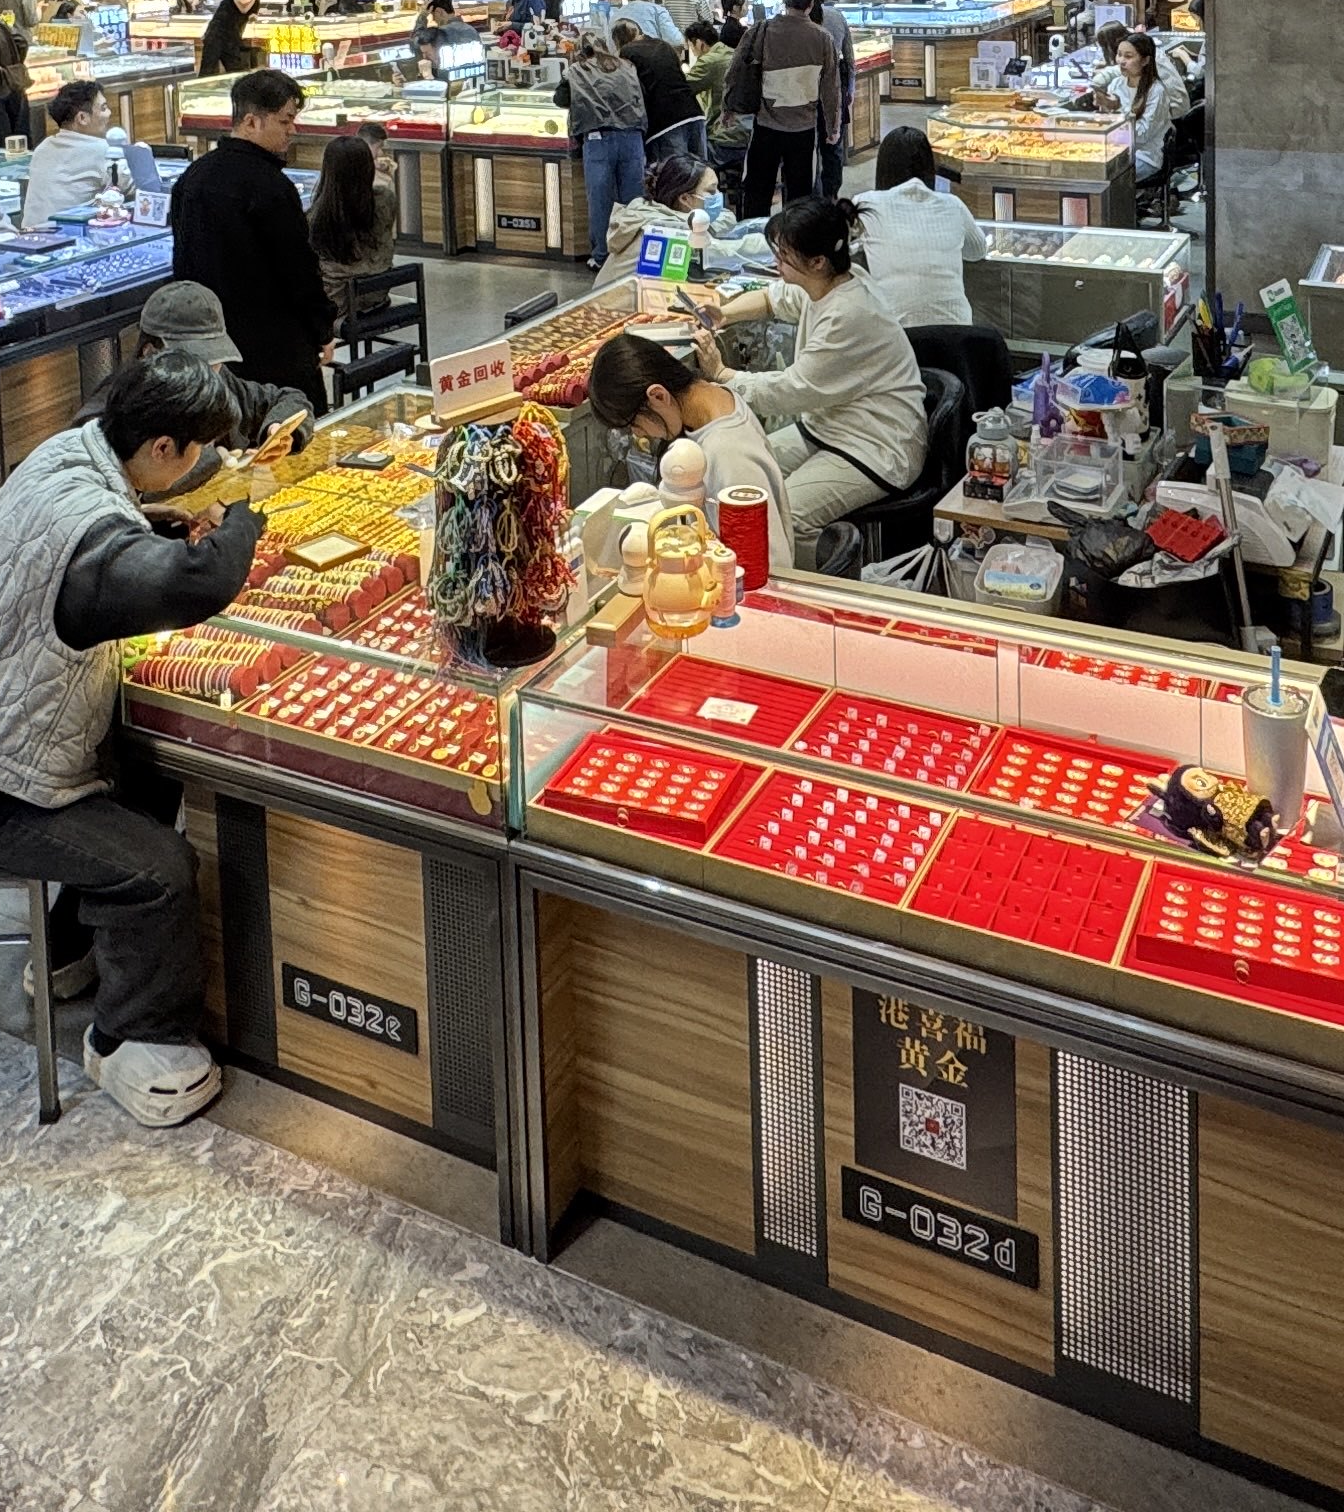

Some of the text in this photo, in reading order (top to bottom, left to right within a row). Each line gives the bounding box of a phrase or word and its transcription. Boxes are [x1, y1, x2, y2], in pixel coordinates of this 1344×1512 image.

[439, 360, 506, 395] 黄金回收
[294, 977, 402, 1042] G-032e
[896, 1036, 969, 1089] 黄金
[859, 1185, 1016, 1303] G-032d
